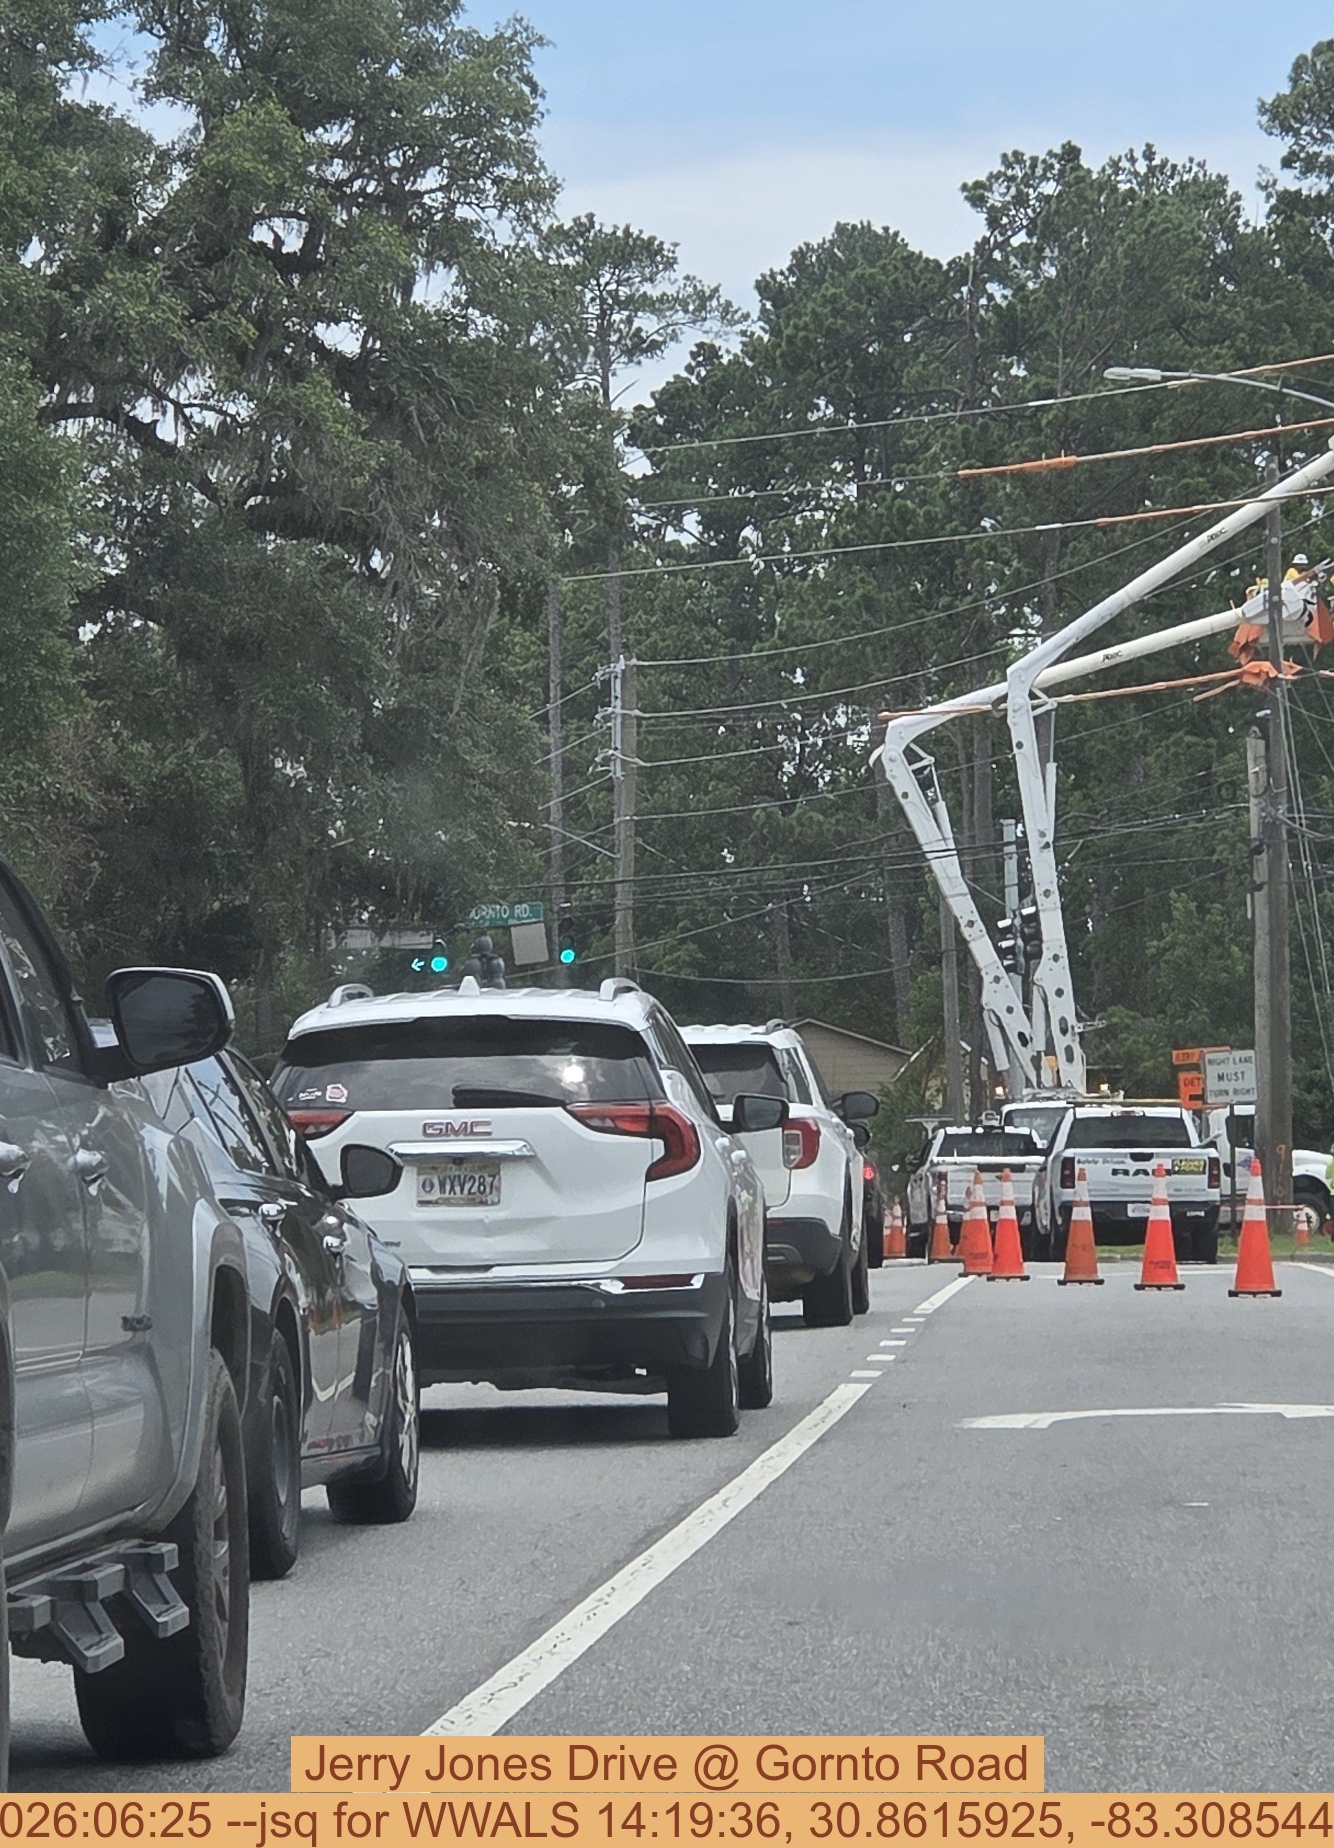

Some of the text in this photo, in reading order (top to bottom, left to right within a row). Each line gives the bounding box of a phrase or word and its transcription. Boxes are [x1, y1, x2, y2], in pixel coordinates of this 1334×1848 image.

[514, 904, 533, 918] RD.
[1208, 1055, 1253, 1066] RIGHT LANE
[1183, 1076, 1201, 1088] DET
[1217, 1070, 1245, 1082] MUST
[1209, 1087, 1255, 1098] TURN RIGHT
[422, 1120, 493, 1138] GMC
[438, 1175, 496, 1196] WXV287
